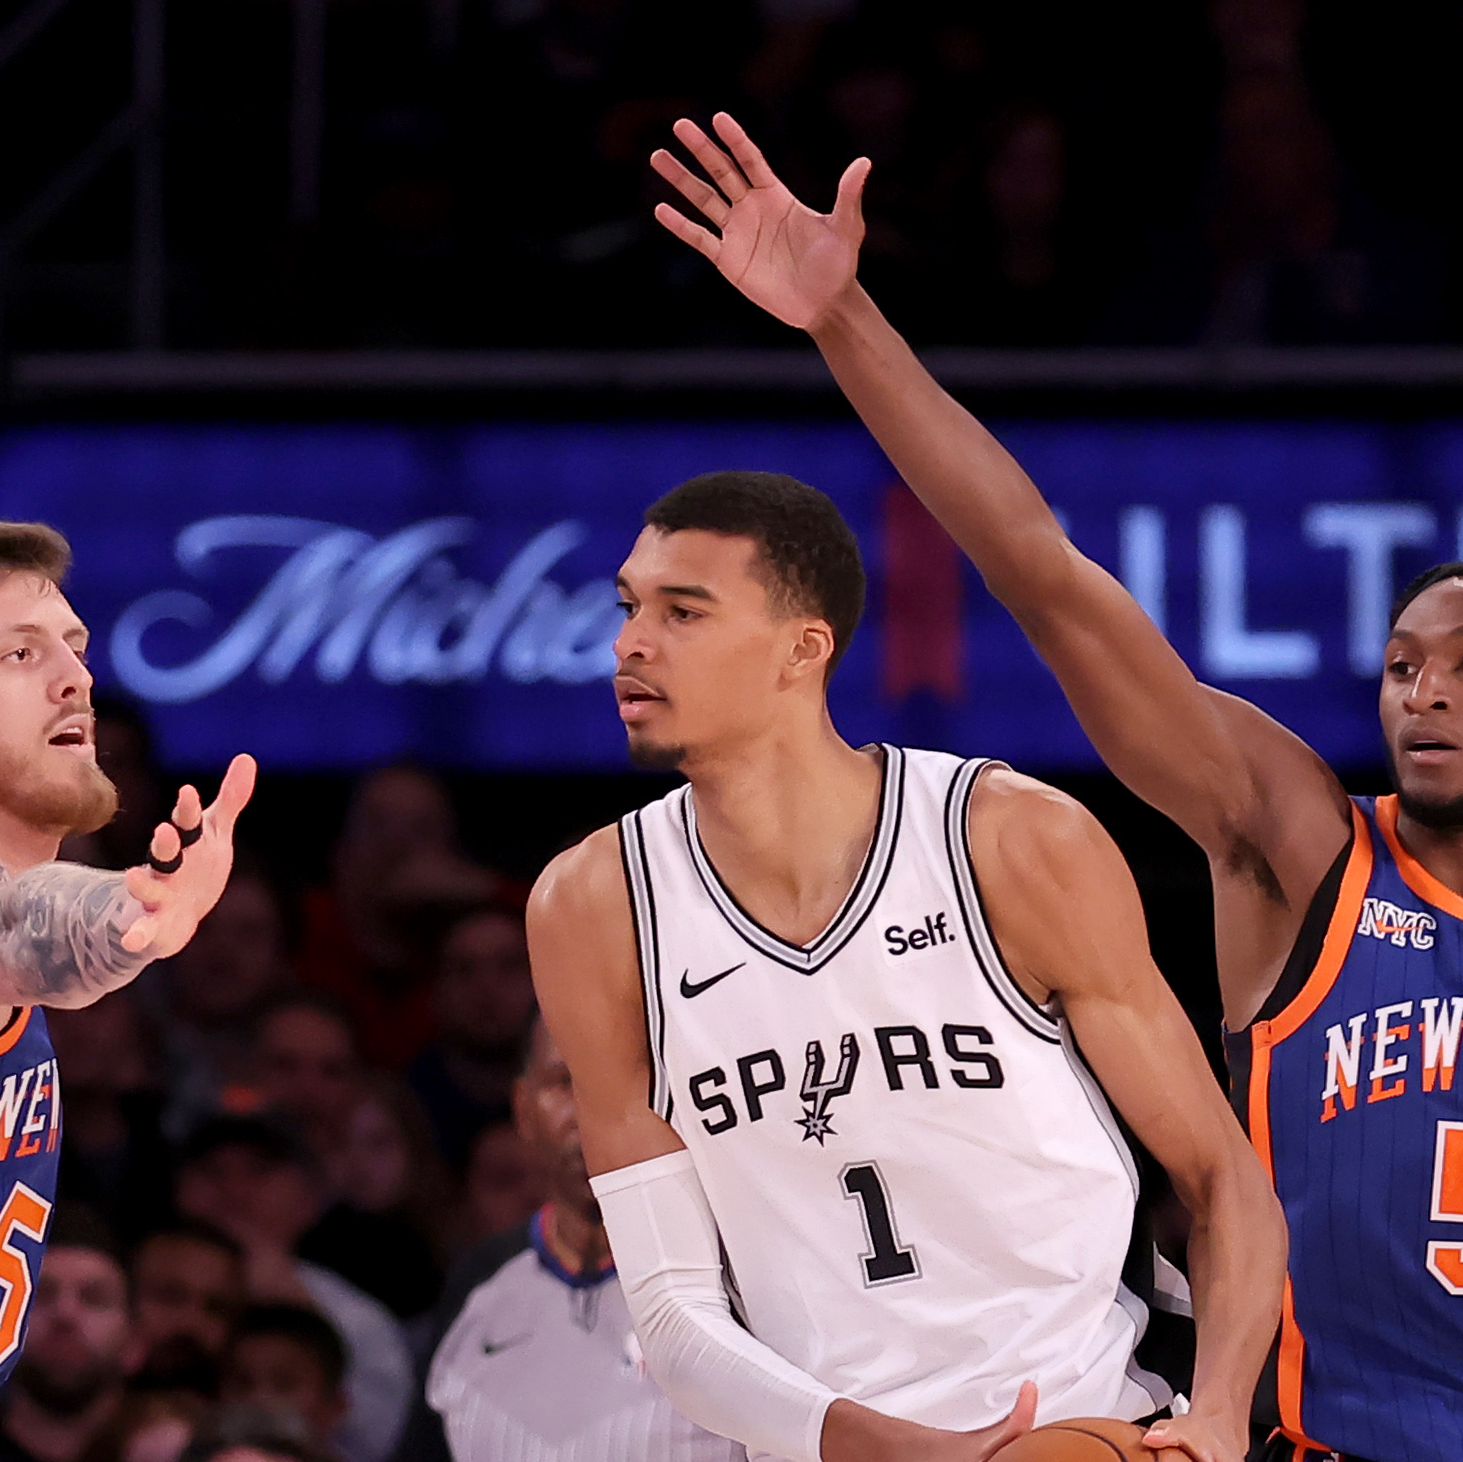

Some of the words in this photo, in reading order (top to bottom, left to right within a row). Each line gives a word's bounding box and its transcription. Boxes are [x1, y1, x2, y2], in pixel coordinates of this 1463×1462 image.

[108, 513, 618, 705] Miche
[884, 912, 956, 956] Self.
[1357, 897, 1437, 951] NYC
[689, 1023, 1005, 1147] SPURS
[839, 1160, 923, 1288] 1
